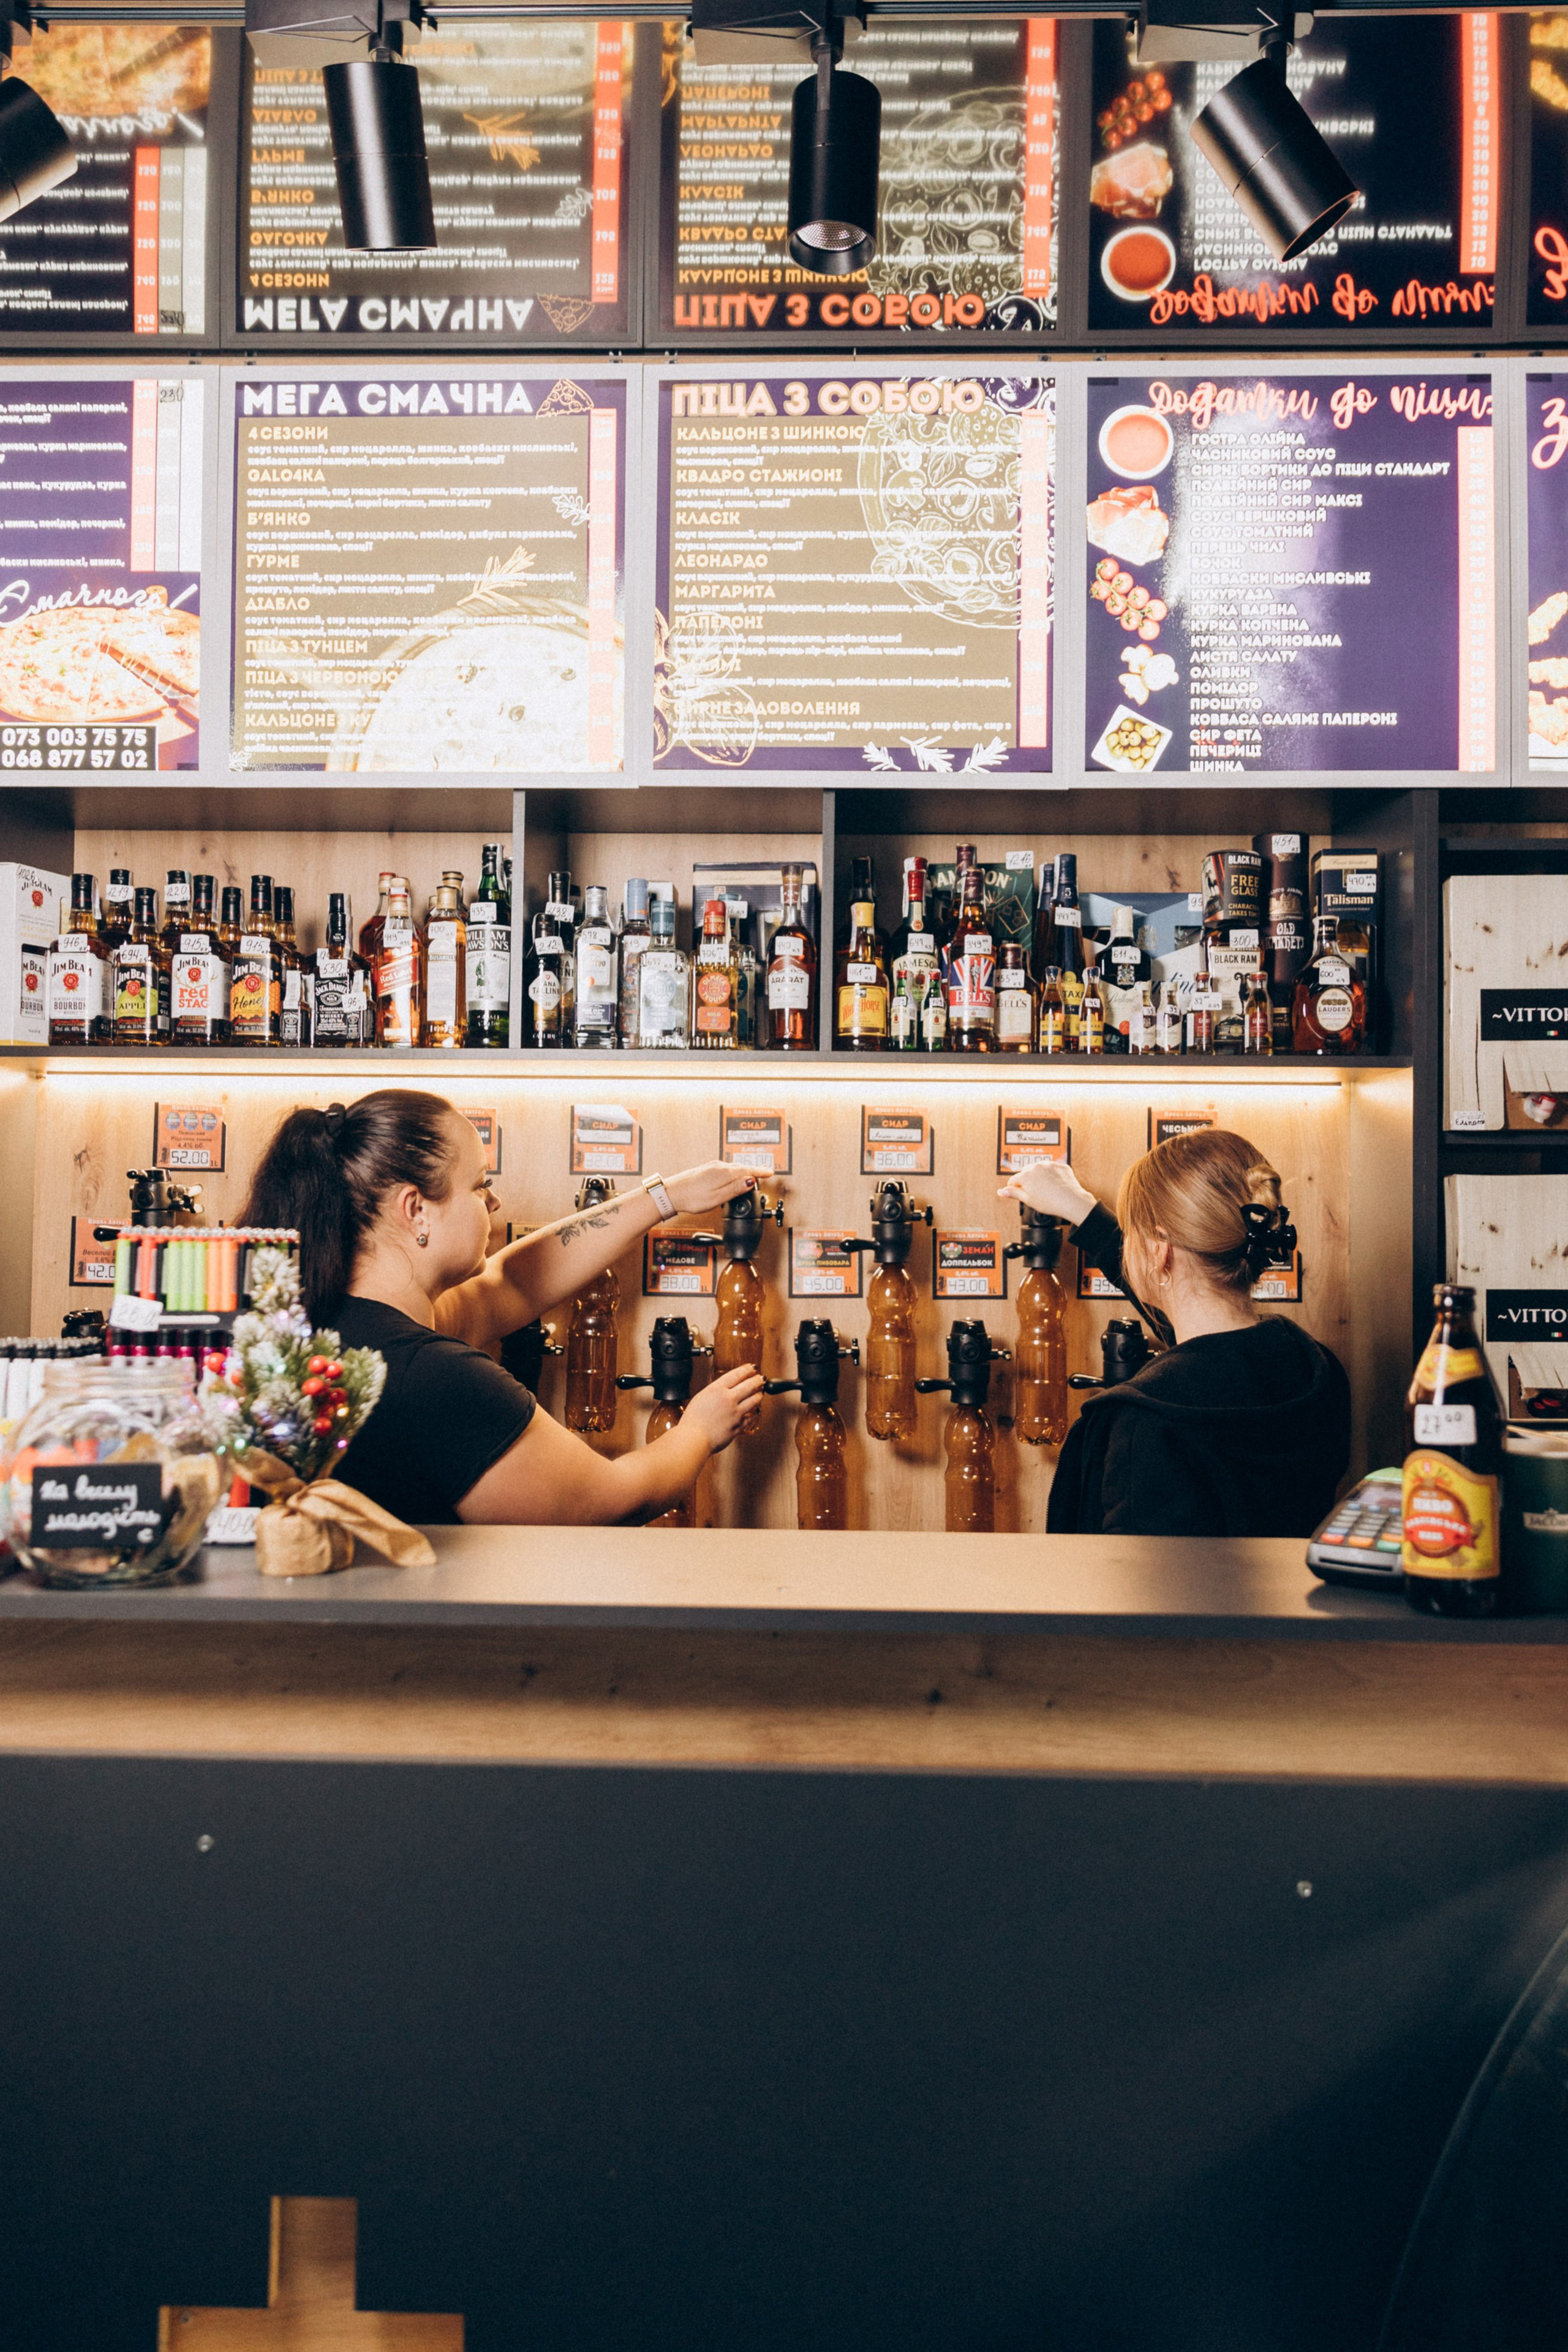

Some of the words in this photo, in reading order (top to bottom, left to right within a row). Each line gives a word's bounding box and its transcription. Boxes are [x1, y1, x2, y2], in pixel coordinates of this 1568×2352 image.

[160, 387, 184, 403] 230
[243, 383, 347, 415] МЕГА
[358, 382, 532, 415] СМАЧНА
[673, 382, 777, 418] ПІЦА
[785, 382, 810, 415] З
[818, 381, 986, 415] СОБОЮ
[1149, 382, 1317, 429] Додатки
[1330, 382, 1378, 429] до
[248, 427, 258, 440] 4
[260, 426, 328, 440] СЕЗОНИ
[677, 426, 768, 442] КАЛЬЦОНЕ
[771, 426, 780, 440] З
[784, 426, 866, 439] ШИНКОЮ
[1191, 432, 1247, 446] ГОСТРА
[1248, 431, 1305, 445] ОЛІЙКА
[1191, 446, 1291, 461] ЧАСНИКОВИЙ
[1294, 448, 1336, 461] СОУС
[248, 469, 325, 482] GALO4KA
[677, 468, 745, 483] КВАДРО
[749, 468, 842, 482] СТАЖИОНІ
[1240, 463, 1307, 476] БОРТИКИ
[1310, 463, 1332, 477] ДО
[1335, 462, 1372, 477] ПІЦИ
[1374, 462, 1450, 477] СТАНДАРТ
[1281, 479, 1312, 492] СИР
[1281, 494, 1313, 507] СИР
[1315, 494, 1363, 507] МАКСІ
[676, 511, 740, 525] КЛАСІК
[1190, 510, 1233, 523] СОУС
[1235, 507, 1327, 522] ВЕРШКОВИЙ
[1190, 526, 1232, 538] СОУС
[1234, 523, 1314, 538] ТОМАТНИЙ
[246, 554, 300, 568] ГУРМЕ
[674, 553, 768, 568] ЛЕОНАРДО
[1190, 572, 1270, 586] КОВБАСКИ
[1273, 571, 1371, 585] МИСЛИВСЬКІ
[675, 584, 775, 598] МАРГАРИТА
[1190, 587, 1275, 601] КУКУРУДЗА
[245, 597, 310, 611] ДІАБЛО
[1190, 604, 1238, 617] КУРКА
[1240, 603, 1298, 617] ВАРЕНА
[674, 616, 763, 630] ПАПЕРОНІ
[1190, 619, 1238, 632] КУРКА
[1240, 619, 1310, 632] КОПЧЕНА
[246, 639, 288, 654] ПІЦА
[301, 639, 368, 654] ТУНЦЕМ
[1190, 635, 1238, 647] КУРКА
[1241, 634, 1342, 647] МАРИНОВАНА
[1189, 650, 1238, 663] ЛИСТЯ
[1241, 650, 1298, 663] САЛАТУ
[246, 671, 287, 685] ПІЦА
[1189, 666, 1251, 679] ОЛИВКИ
[1190, 682, 1259, 696] ПОМІДОР
[736, 701, 860, 716] ЗАДОВОЛЕННЯ
[1190, 698, 1263, 710] ПРОШУТО
[246, 714, 335, 729] КАЛЬЦОНЕ
[1190, 714, 1261, 726] КОВБАСА
[1262, 713, 1319, 726] САЛЯМІ
[1322, 712, 1398, 726] ПАПЕРОНІ
[2, 728, 40, 747] 073
[47, 728, 87, 747] 003
[92, 728, 116, 746] 75
[122, 728, 147, 746] 75
[1189, 729, 1221, 742] СИР
[1223, 729, 1263, 742] ФЕТА
[2, 749, 42, 767] 068
[48, 749, 85, 767] 877
[91, 750, 116, 767] 57
[121, 749, 148, 767] 02
[1189, 744, 1262, 758] ПЕЧЕРИЦІ
[1189, 761, 1245, 772] ШИНКА
[1228, 854, 1250, 865] BLACK
[1231, 875, 1259, 887] FREE
[1348, 876, 1365, 886] 470
[1065, 888, 1072, 897] 5
[1231, 886, 1259, 896] GLASS
[1324, 894, 1374, 906] Talisman
[1276, 922, 1295, 935] OLD
[702, 949, 716, 958] 706
[1215, 954, 1238, 964] BLACK
[1240, 954, 1257, 963] RAM
[51, 963, 66, 978] JIM
[177, 957, 191, 971] JIM
[118, 970, 130, 984] JIM
[233, 964, 249, 980] JIM
[380, 973, 394, 984] Red
[702, 974, 727, 986] OLMECA
[178, 984, 209, 999] red
[315, 984, 328, 996] JACK
[702, 991, 728, 1003] TEQUILA
[956, 990, 991, 1003] BELL'S
[861, 999, 880, 1012] HORSE
[592, 1121, 619, 1129] СИДР
[740, 1121, 767, 1129] СИДР
[882, 1119, 908, 1128] СИДР
[1019, 1122, 1046, 1131] СИДР
[171, 1151, 209, 1164] 52.00
[876, 1152, 914, 1166] 36.00
[962, 1244, 994, 1255] ЗЕМАН
[941, 1259, 993, 1267] ДОППЕЛЬБОК
[662, 1276, 699, 1290] 38.00
[949, 1278, 986, 1292] 43.00
